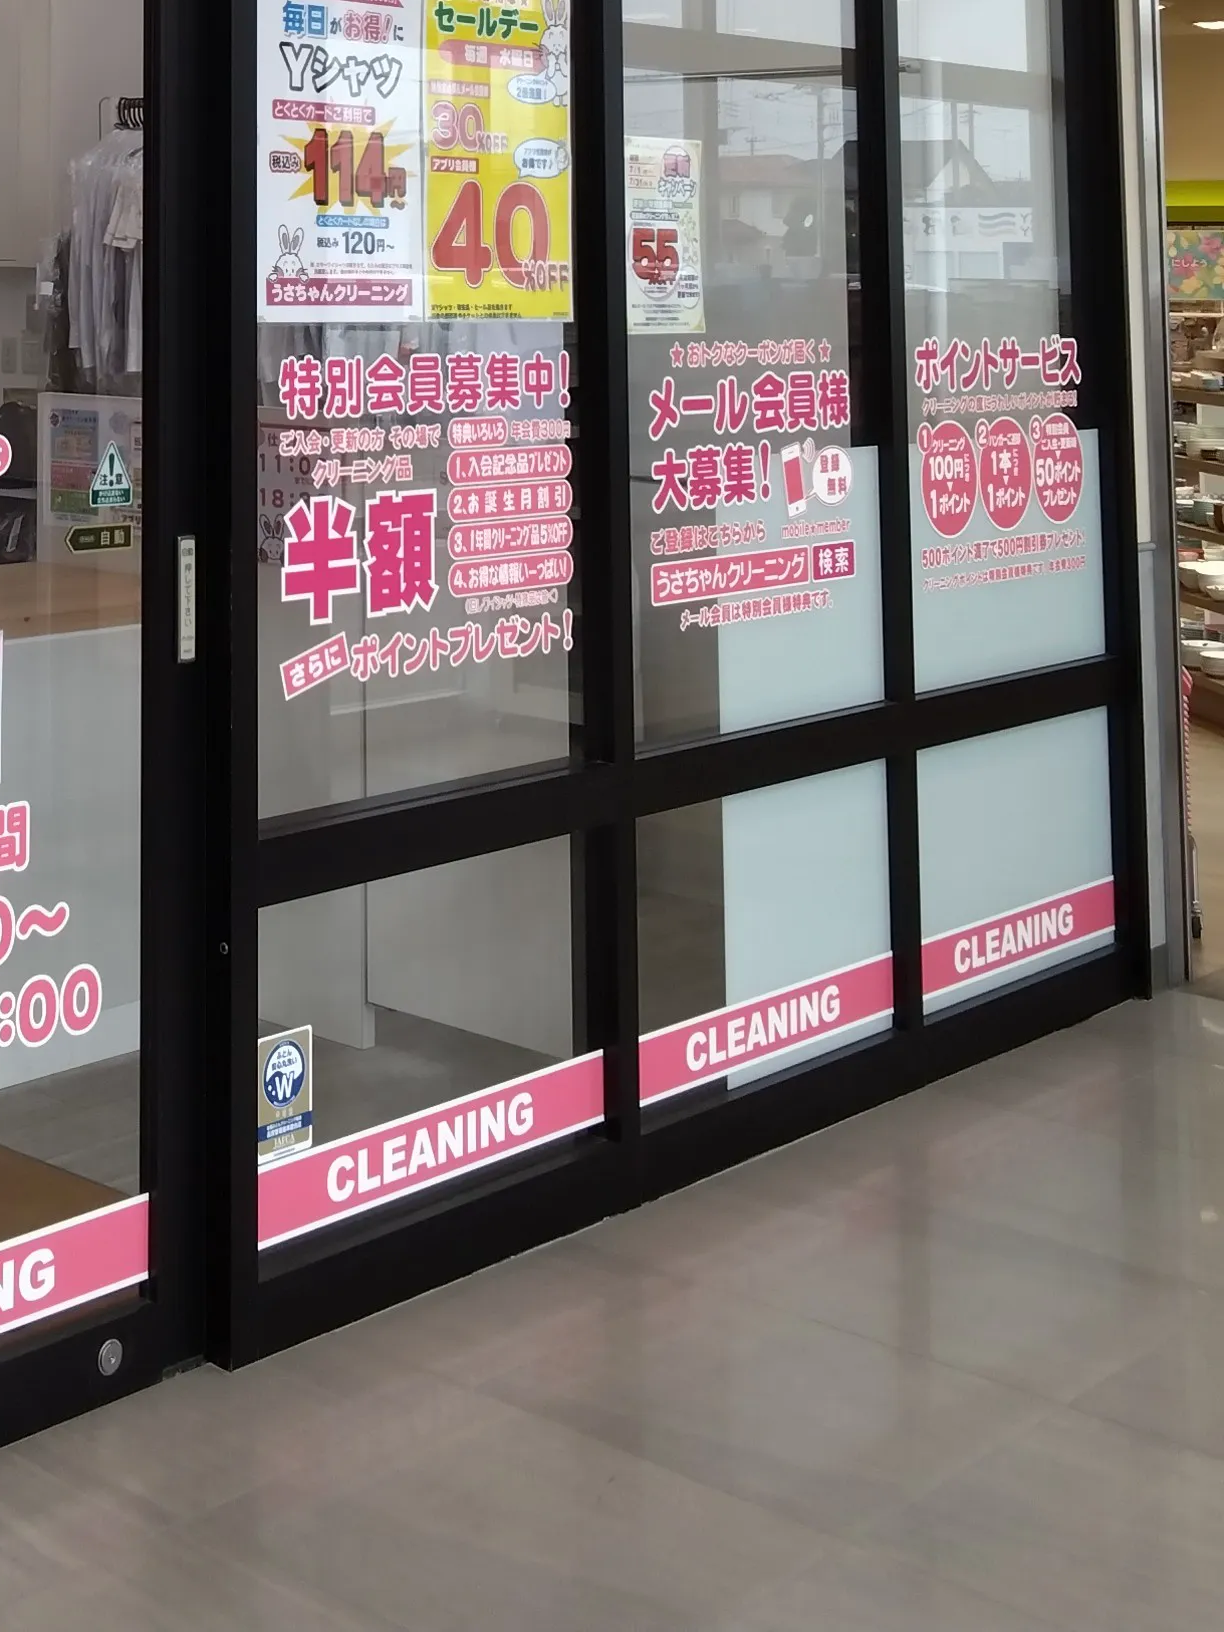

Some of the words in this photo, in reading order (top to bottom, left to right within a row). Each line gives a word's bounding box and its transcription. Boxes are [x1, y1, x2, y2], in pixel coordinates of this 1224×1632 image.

[433, 0, 540, 39] セールデー
[278, 41, 403, 99] Yシャツ
[271, 282, 409, 303] うさちゃんクリーニング
[914, 334, 1082, 394] ポイントサービス
[648, 368, 851, 442] メール会員様
[311, 454, 414, 489] クリーニング品
[280, 488, 440, 626] 半額
[656, 551, 807, 599] うさちゃんクリーニング
[817, 545, 850, 577] 検索
[288, 640, 344, 689] さらに
[952, 902, 1075, 975] CLEANING
[684, 983, 842, 1073] CLEANING
[325, 1091, 535, 1204] CLEANING
